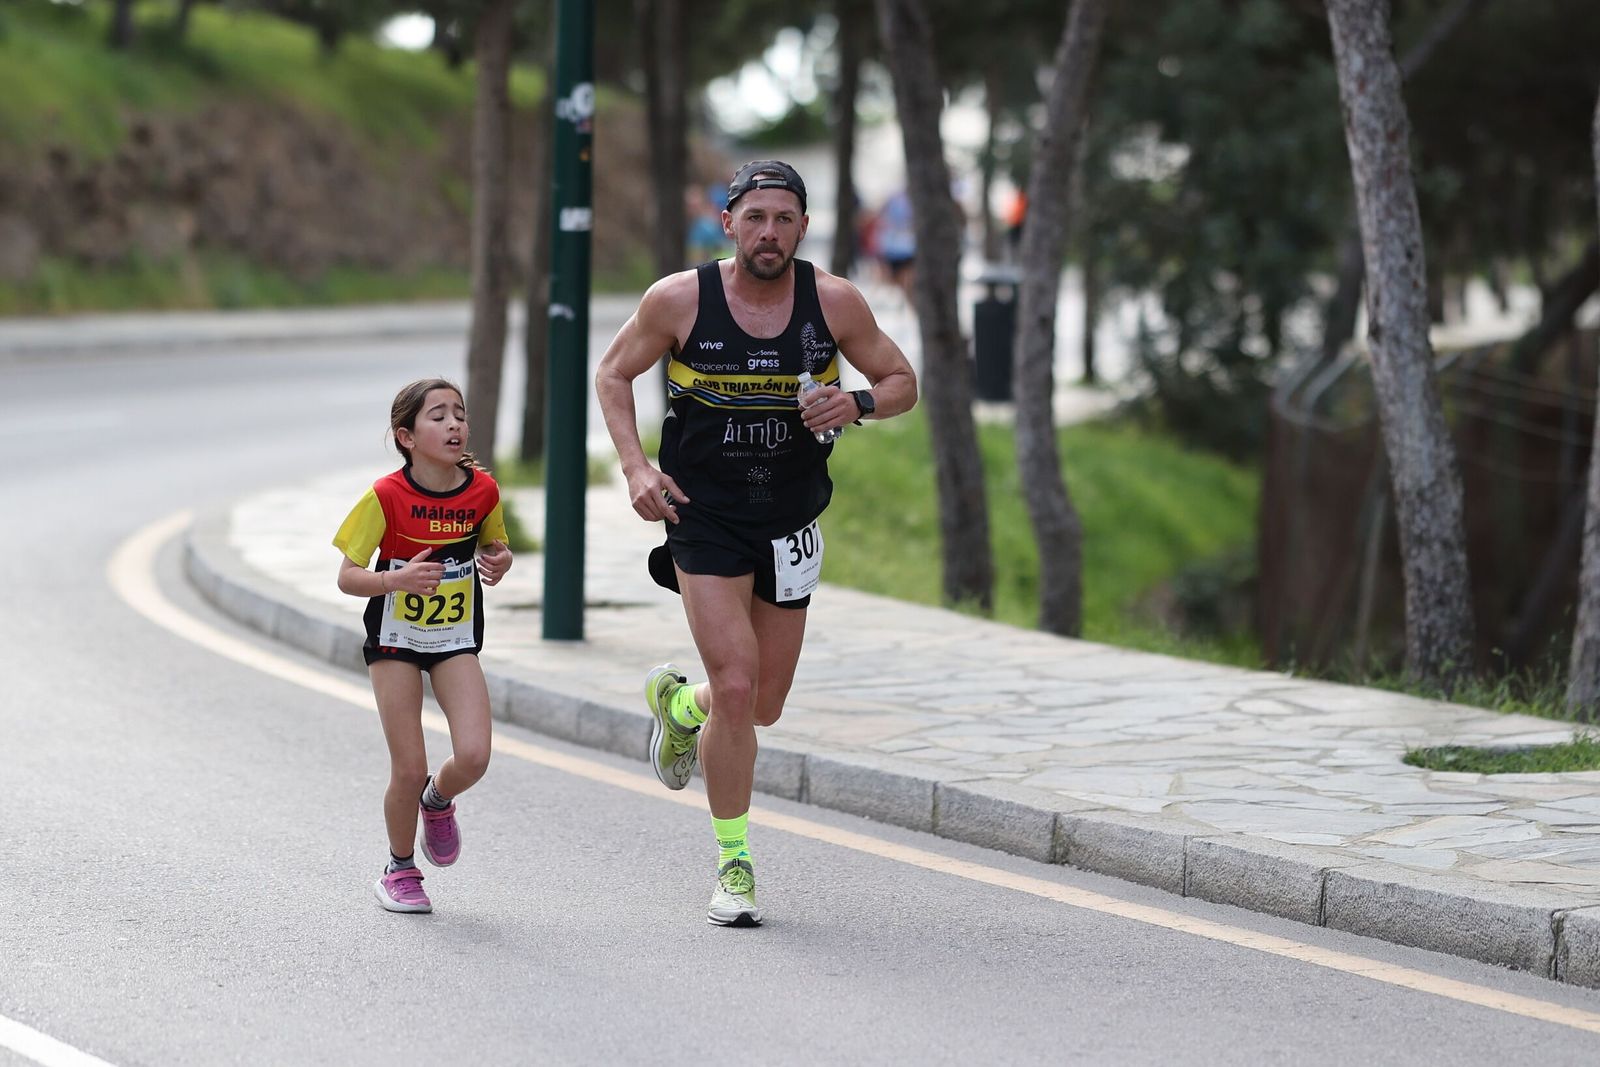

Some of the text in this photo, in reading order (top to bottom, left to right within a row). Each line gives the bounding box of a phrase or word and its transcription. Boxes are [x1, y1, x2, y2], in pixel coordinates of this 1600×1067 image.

[699, 340, 724, 350] vive
[692, 378, 721, 390] CLUB
[721, 379, 781, 393] TRIATLÓN
[411, 505, 476, 523] Málaga
[429, 520, 474, 533] Bahía
[404, 592, 466, 625] 923
